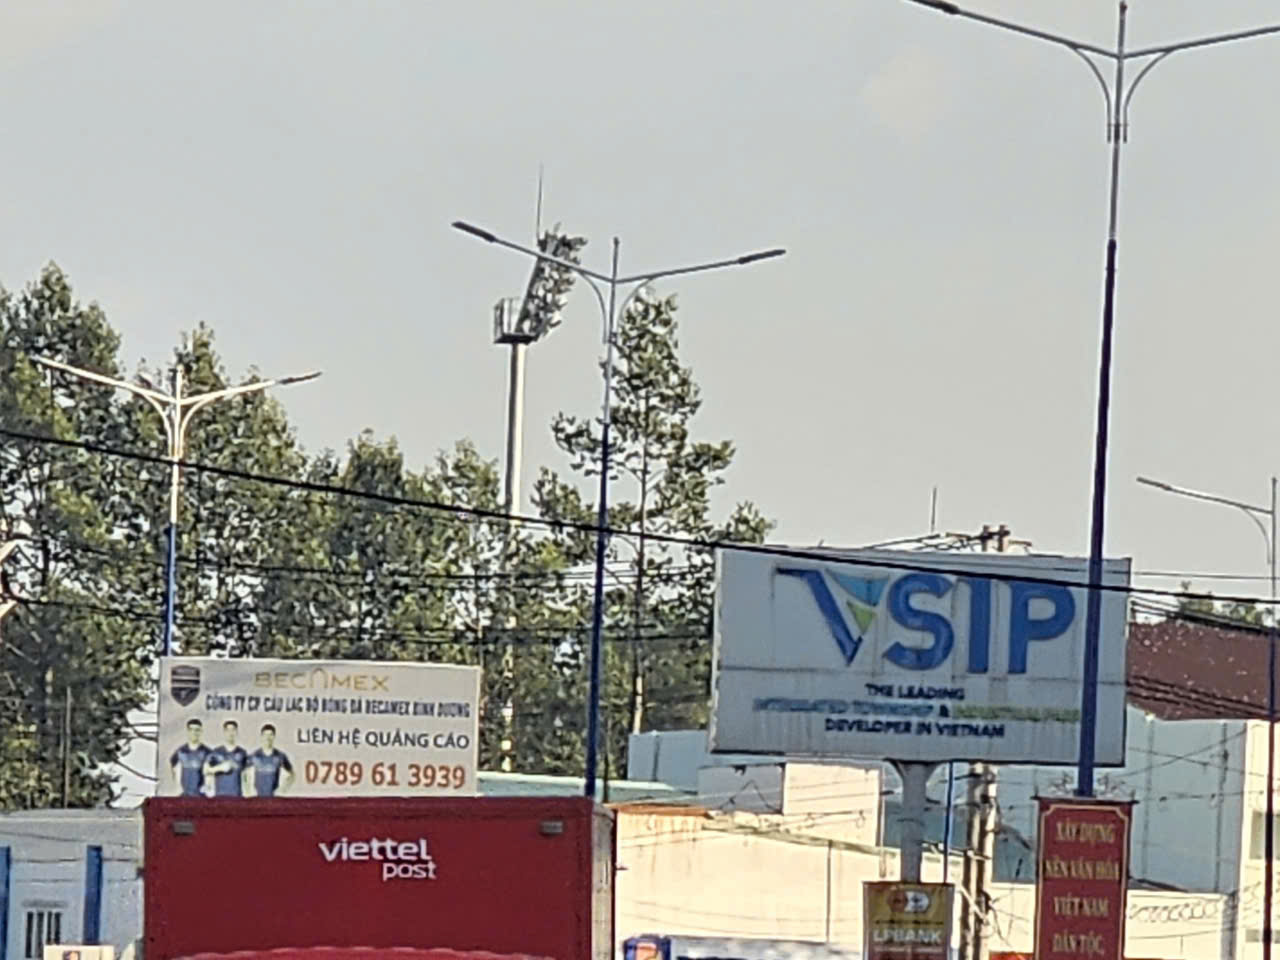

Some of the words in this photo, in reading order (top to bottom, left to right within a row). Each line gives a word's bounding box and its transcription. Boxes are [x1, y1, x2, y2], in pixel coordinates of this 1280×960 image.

[776, 566, 1077, 676] VSIP
[297, 728, 334, 744] LIÊN
[338, 728, 361, 748] HỆ
[365, 728, 430, 748] QUẢNG
[433, 731, 470, 749] CÁO
[305, 760, 363, 786] 0789
[371, 762, 400, 786] 61
[407, 763, 466, 789] 3939
[318, 837, 432, 861] viettel
[382, 861, 437, 881] post
